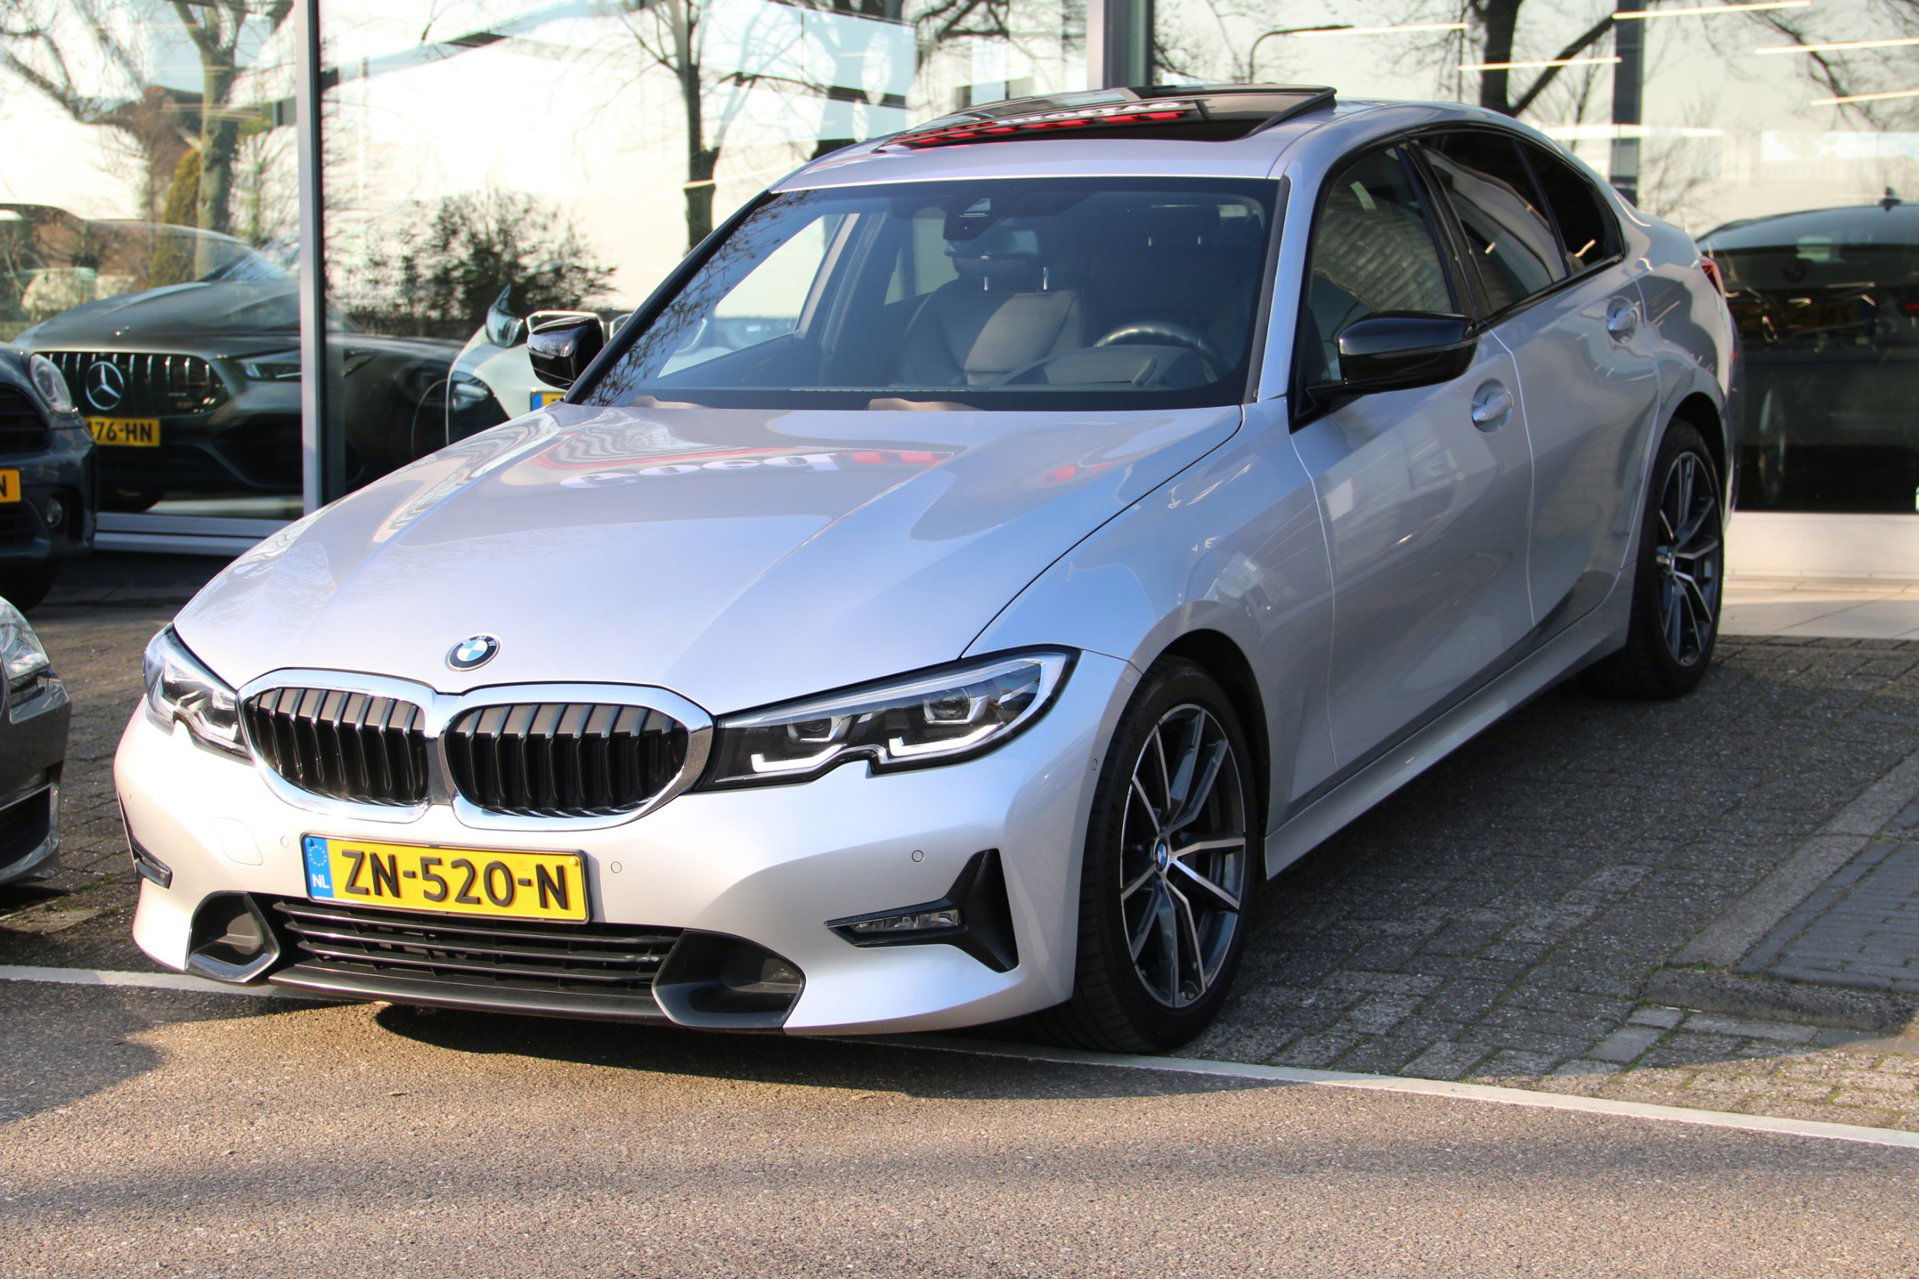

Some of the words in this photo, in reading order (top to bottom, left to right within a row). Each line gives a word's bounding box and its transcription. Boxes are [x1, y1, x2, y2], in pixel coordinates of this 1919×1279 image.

[89, 421, 152, 442] 76-HN
[312, 874, 330, 888] NL
[341, 849, 571, 910] ZN-520-N
